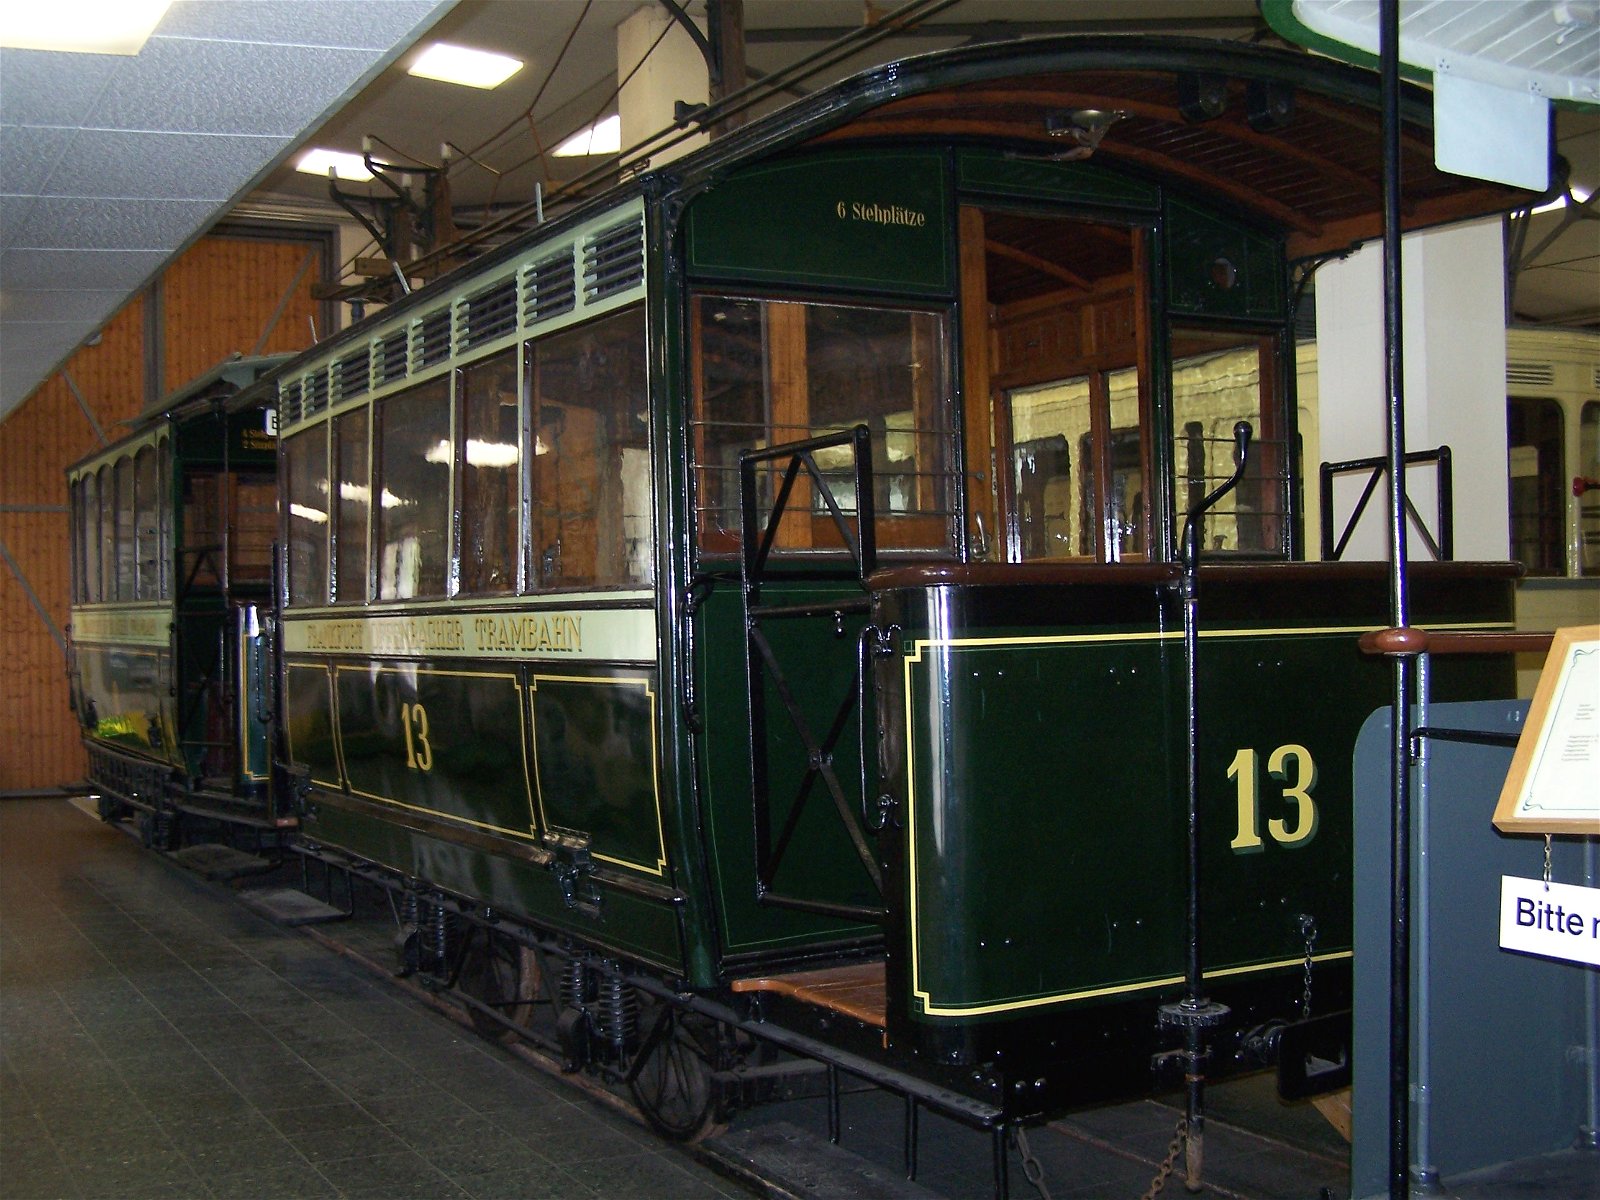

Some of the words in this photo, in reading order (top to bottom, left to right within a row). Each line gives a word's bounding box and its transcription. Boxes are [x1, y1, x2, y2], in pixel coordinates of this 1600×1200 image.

[837, 201, 846, 219] 6
[852, 202, 926, 227] Stehplätze
[475, 614, 582, 652] TRAMBAHN
[402, 703, 433, 770] 13
[1227, 744, 1318, 853] 13
[1516, 896, 1584, 936] Bitte
